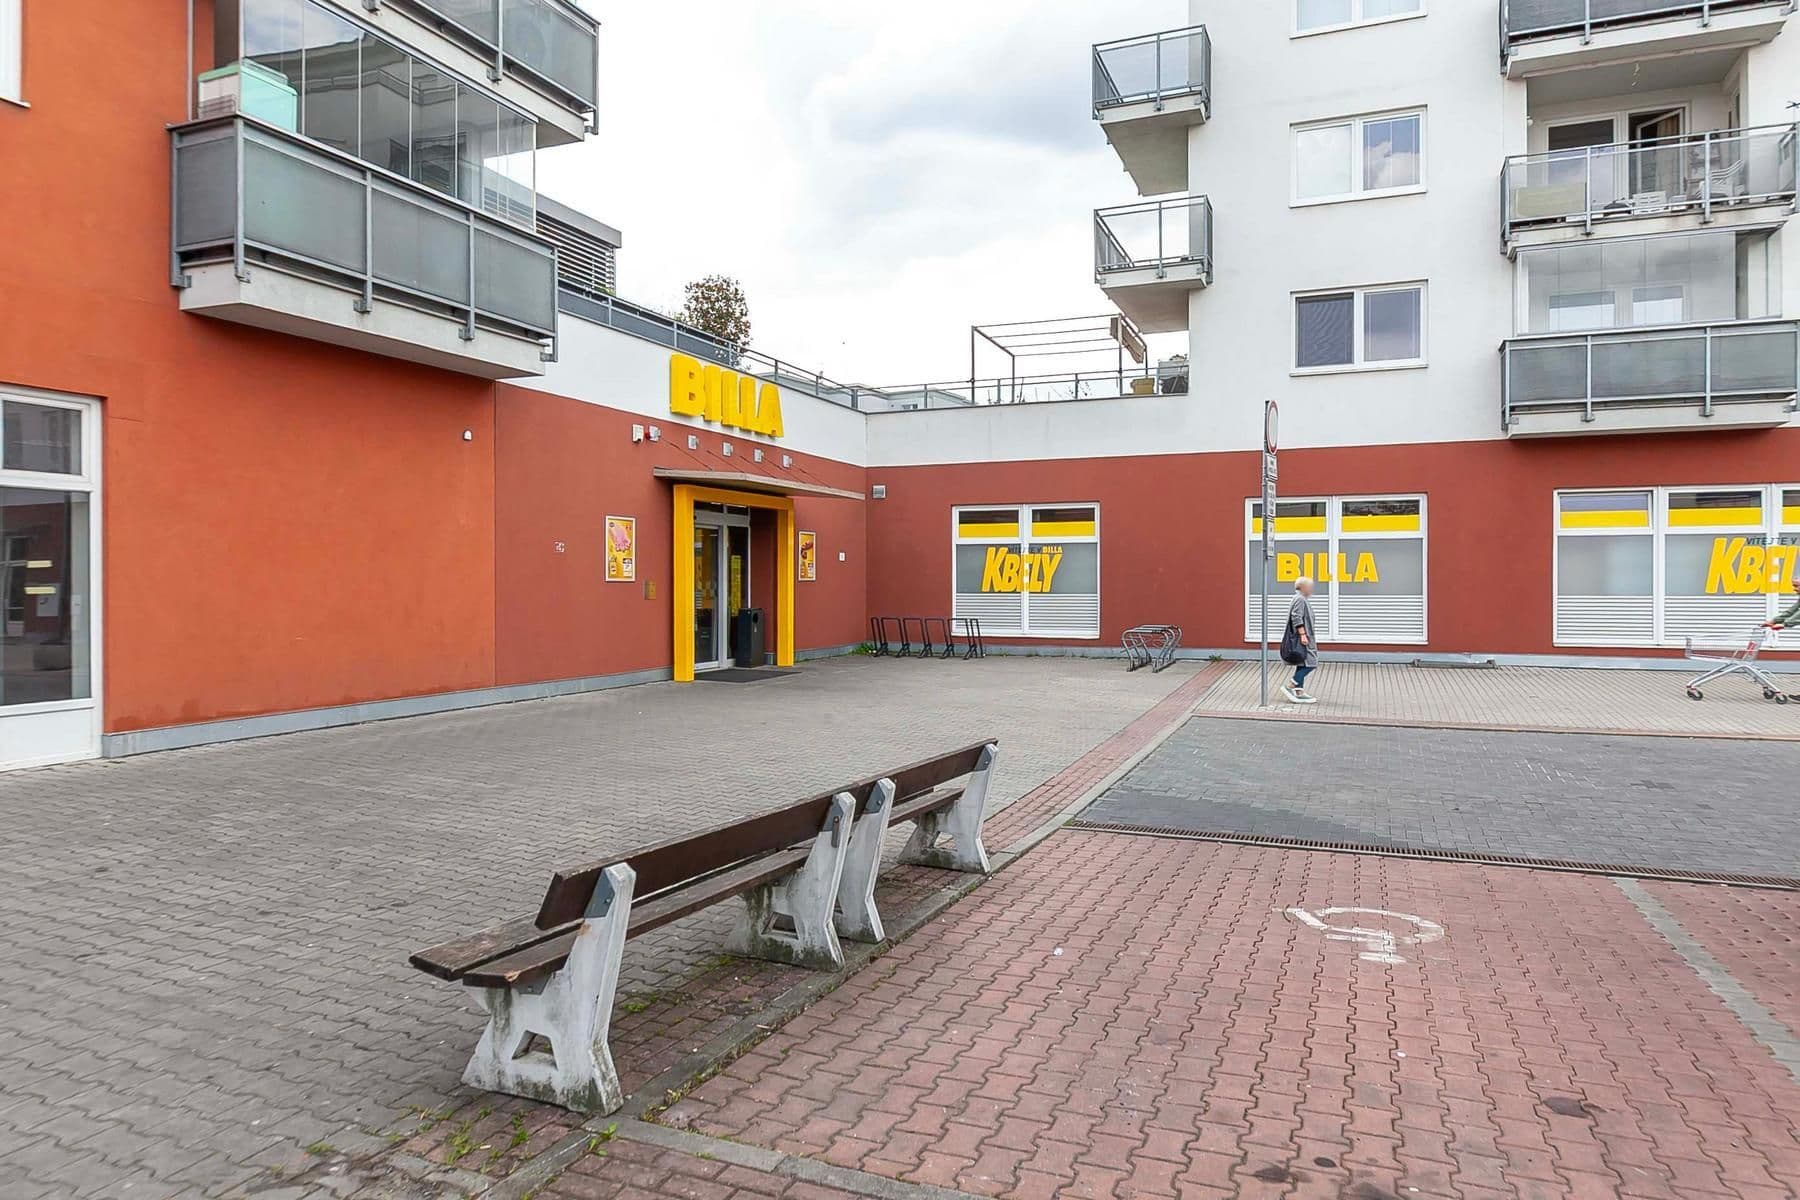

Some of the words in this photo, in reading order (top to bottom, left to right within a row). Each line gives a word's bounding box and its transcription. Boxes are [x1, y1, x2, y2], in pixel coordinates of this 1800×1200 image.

[670, 353, 784, 438] BILLA
[982, 546, 1063, 592] KBELY
[1042, 545, 1063, 553] BILLA
[1276, 552, 1379, 582] BILLA
[1705, 537, 1800, 594] KBEL
